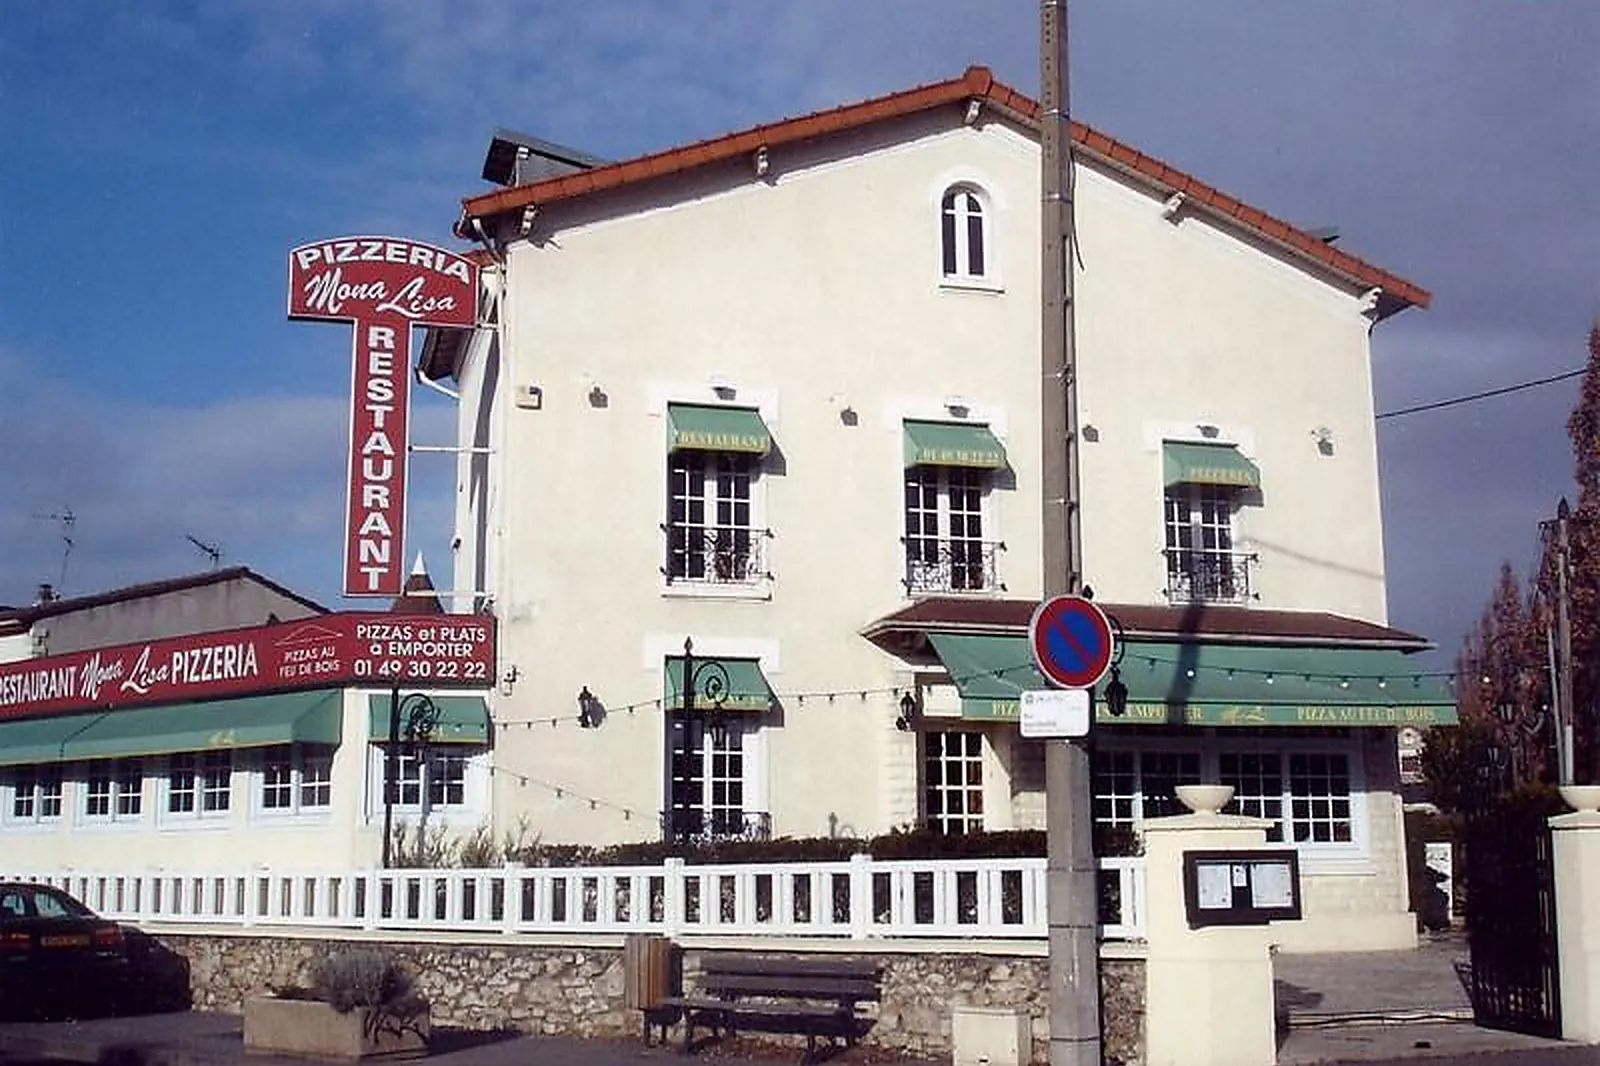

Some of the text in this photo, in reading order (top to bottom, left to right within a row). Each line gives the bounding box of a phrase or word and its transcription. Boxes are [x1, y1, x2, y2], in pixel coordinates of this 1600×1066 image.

[296, 241, 470, 285] PIZZERIA
[304, 267, 458, 319] Mona Lisa
[358, 326, 395, 591] RESTAURANT
[356, 625, 487, 643] PIZZAS et PLATS
[284, 645, 336, 664] PIZZAS AU
[388, 641, 473, 658] EMPORTER
[80, 652, 126, 701] Mona
[120, 645, 171, 695] Lisa
[172, 642, 259, 686] PIZZERIA
[315, 659, 341, 673] BOIS
[354, 660, 486, 678] 01 49 30 22 22
